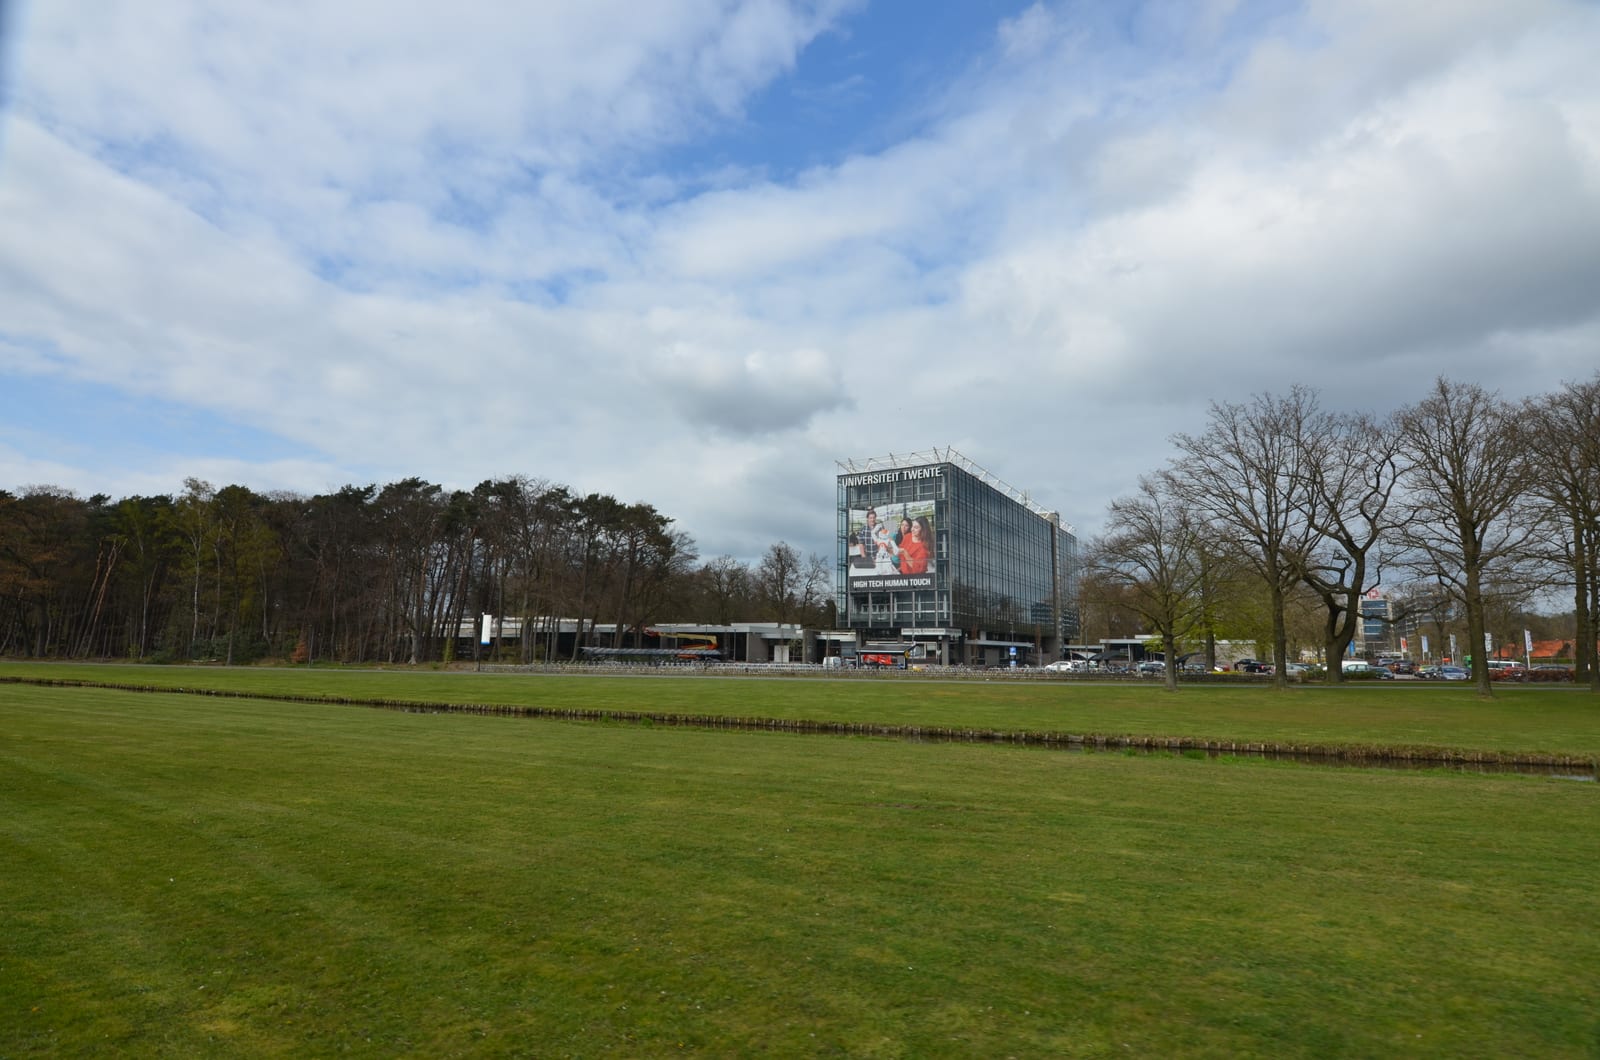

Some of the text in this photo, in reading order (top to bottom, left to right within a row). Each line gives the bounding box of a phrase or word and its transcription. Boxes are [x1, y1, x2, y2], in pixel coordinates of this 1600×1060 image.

[842, 471, 900, 487] UNIVERSITEIT
[853, 578, 931, 588] HIGH TECH HUMAN TOUCH
